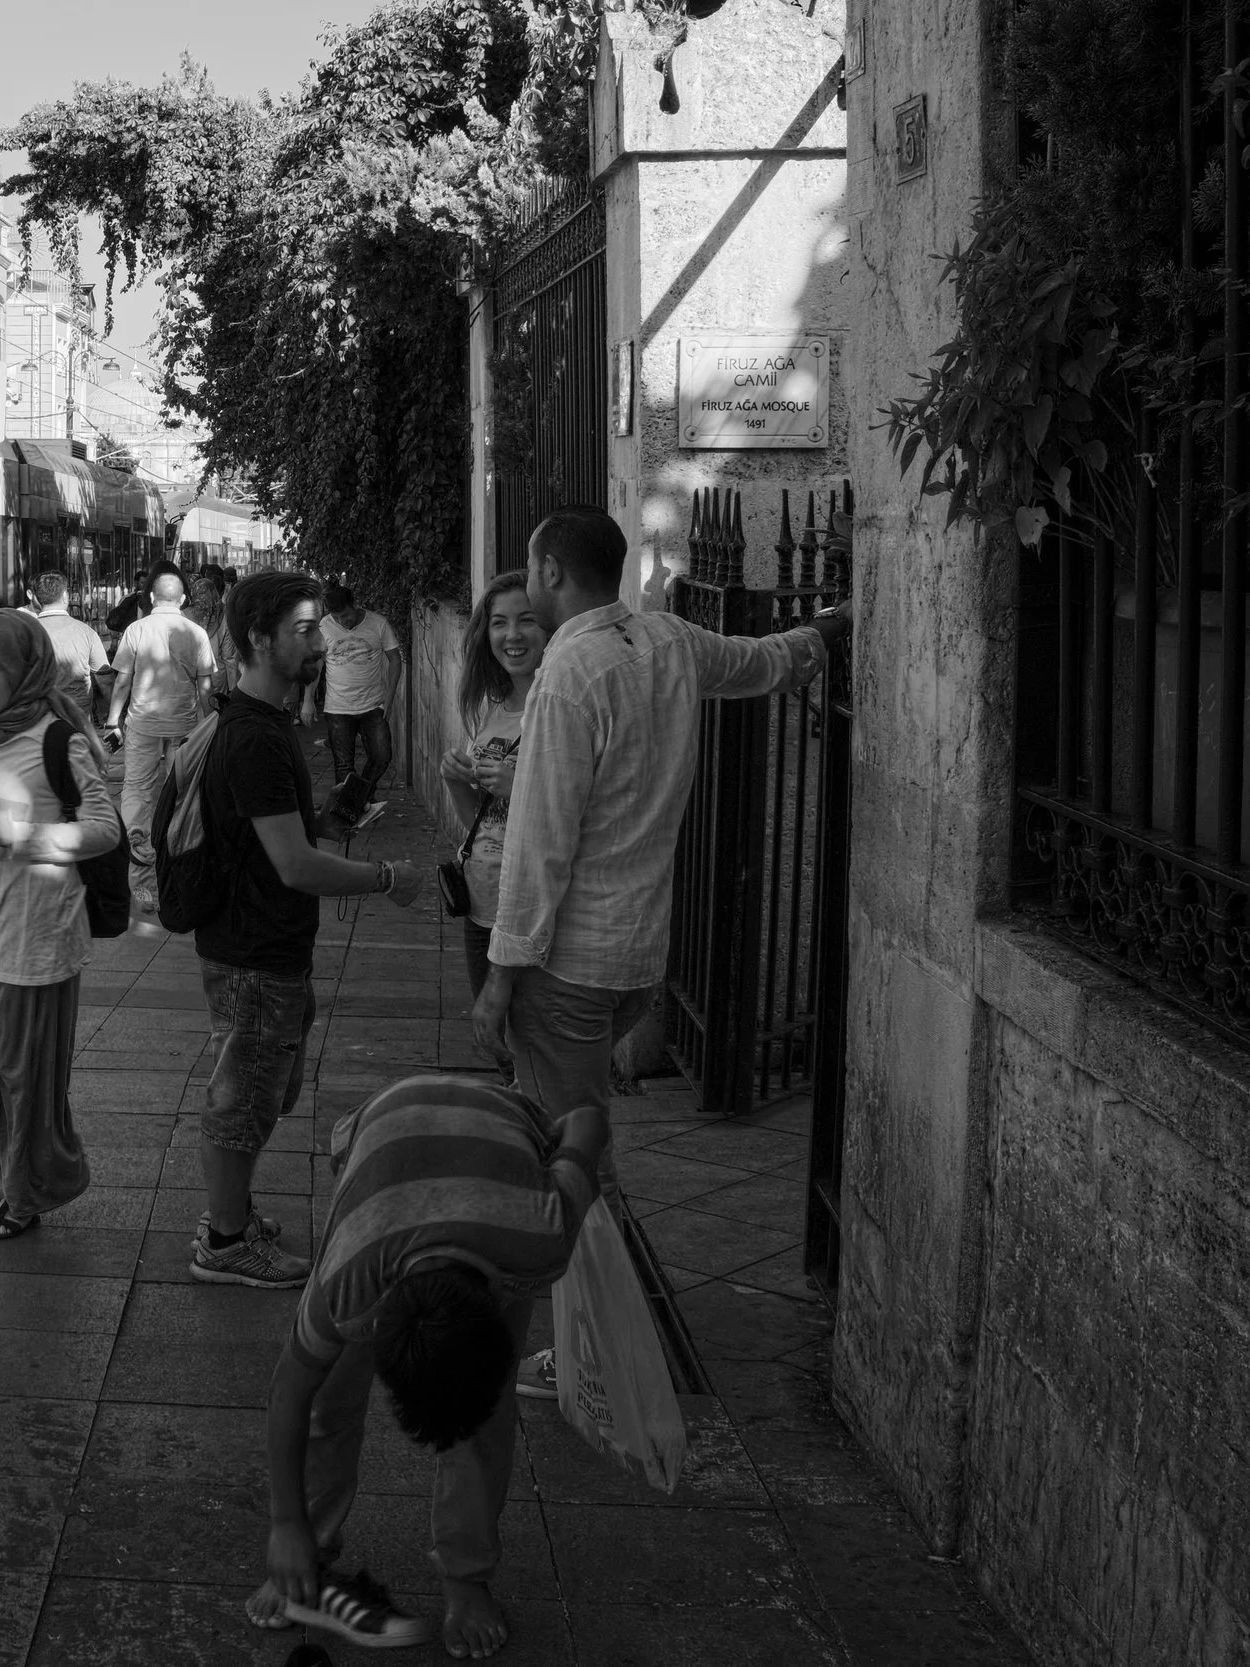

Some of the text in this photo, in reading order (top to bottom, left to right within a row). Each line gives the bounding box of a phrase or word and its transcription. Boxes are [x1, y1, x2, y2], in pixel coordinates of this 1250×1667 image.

[717, 355, 796, 371] FİRUZ AĞA
[733, 371, 777, 387] CAMİİ
[701, 398, 810, 414] FİRUZ AĞA MOSQUE
[744, 418, 766, 429] 1491
